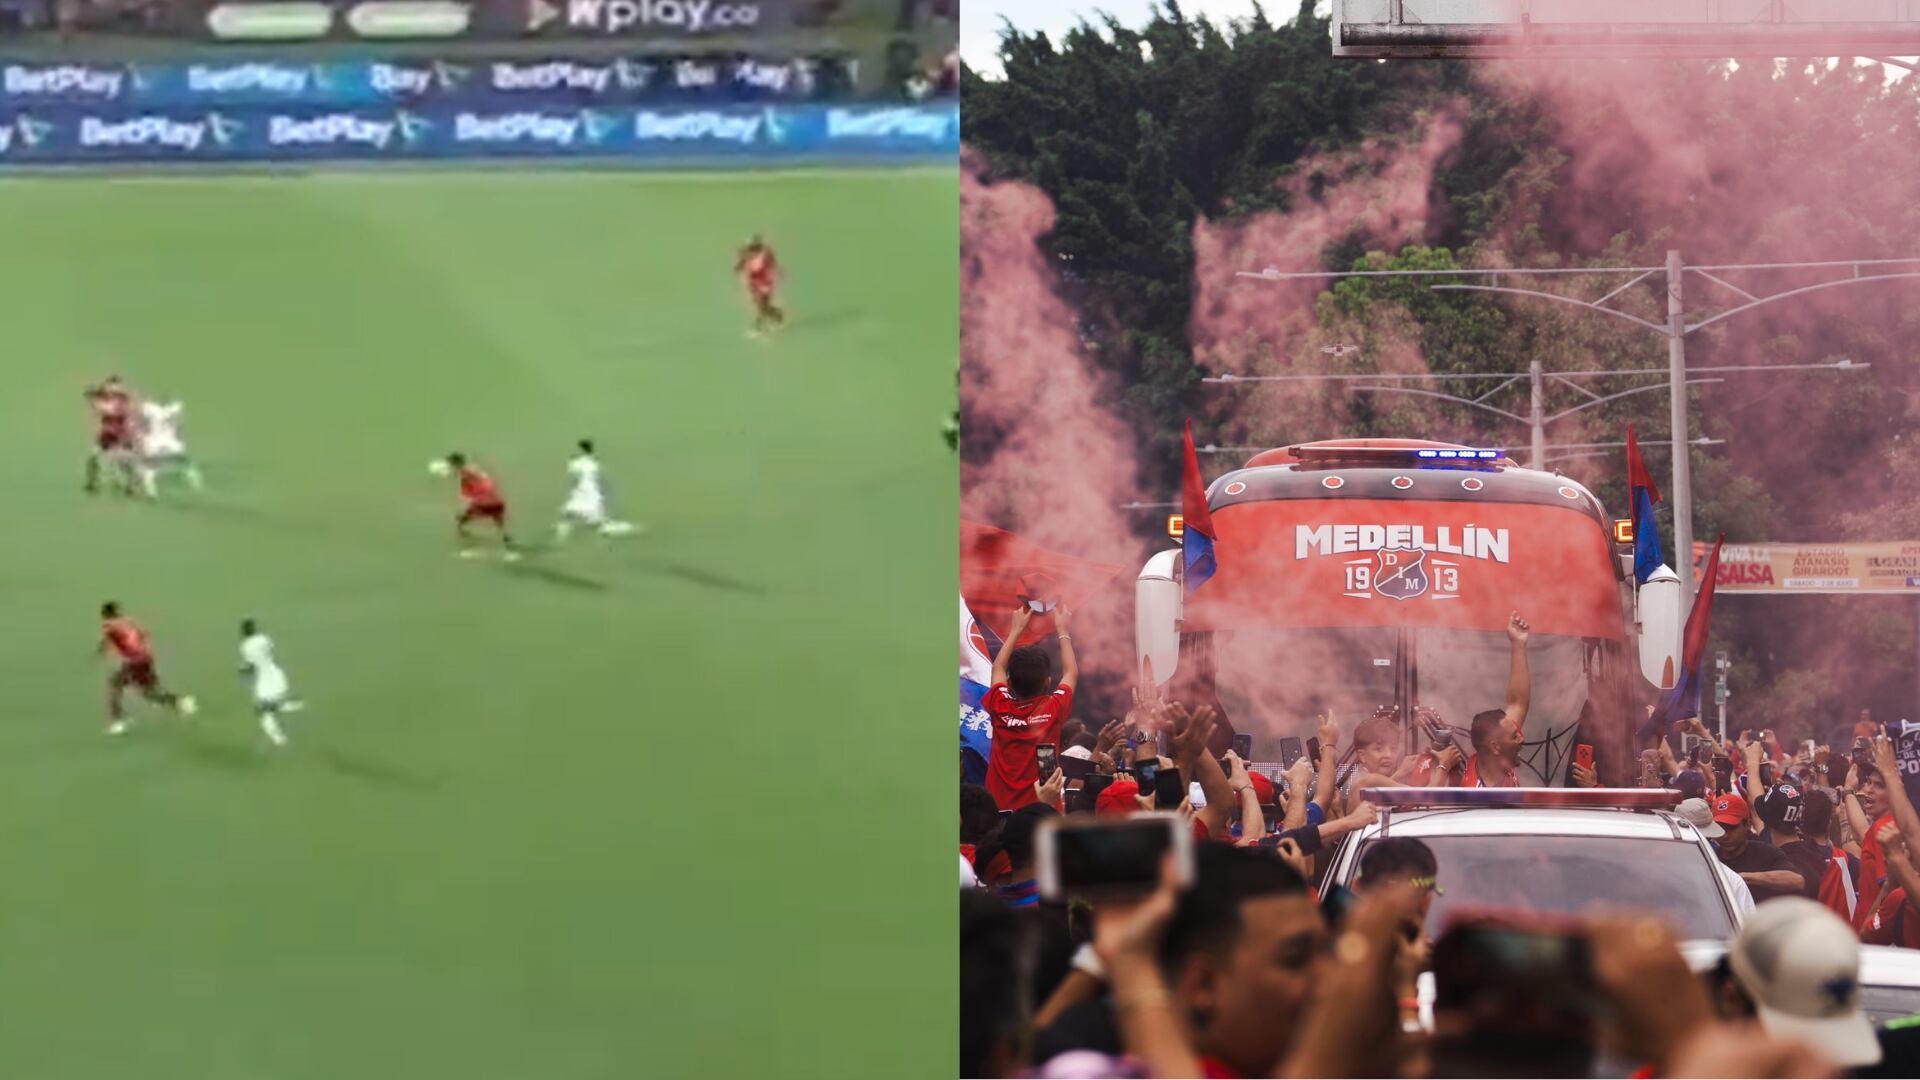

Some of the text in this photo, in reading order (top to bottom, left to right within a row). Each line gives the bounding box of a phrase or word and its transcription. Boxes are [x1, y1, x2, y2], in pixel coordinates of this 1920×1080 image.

[4, 65, 122, 98] BetPlay
[188, 63, 308, 94] BetPlay
[492, 61, 611, 91] BetPlay
[80, 116, 204, 149] BetPlay
[269, 113, 396, 149] BetPlay
[455, 112, 579, 145] BetPlay
[635, 110, 765, 142] BetPlay
[1296, 523, 1509, 563] MEDELLÍN
[1345, 566, 1459, 591] 19 13
[1716, 562, 1774, 585] SALSA
[1792, 567, 1849, 576] GIRARDOT
[1896, 759, 1920, 776] PO
